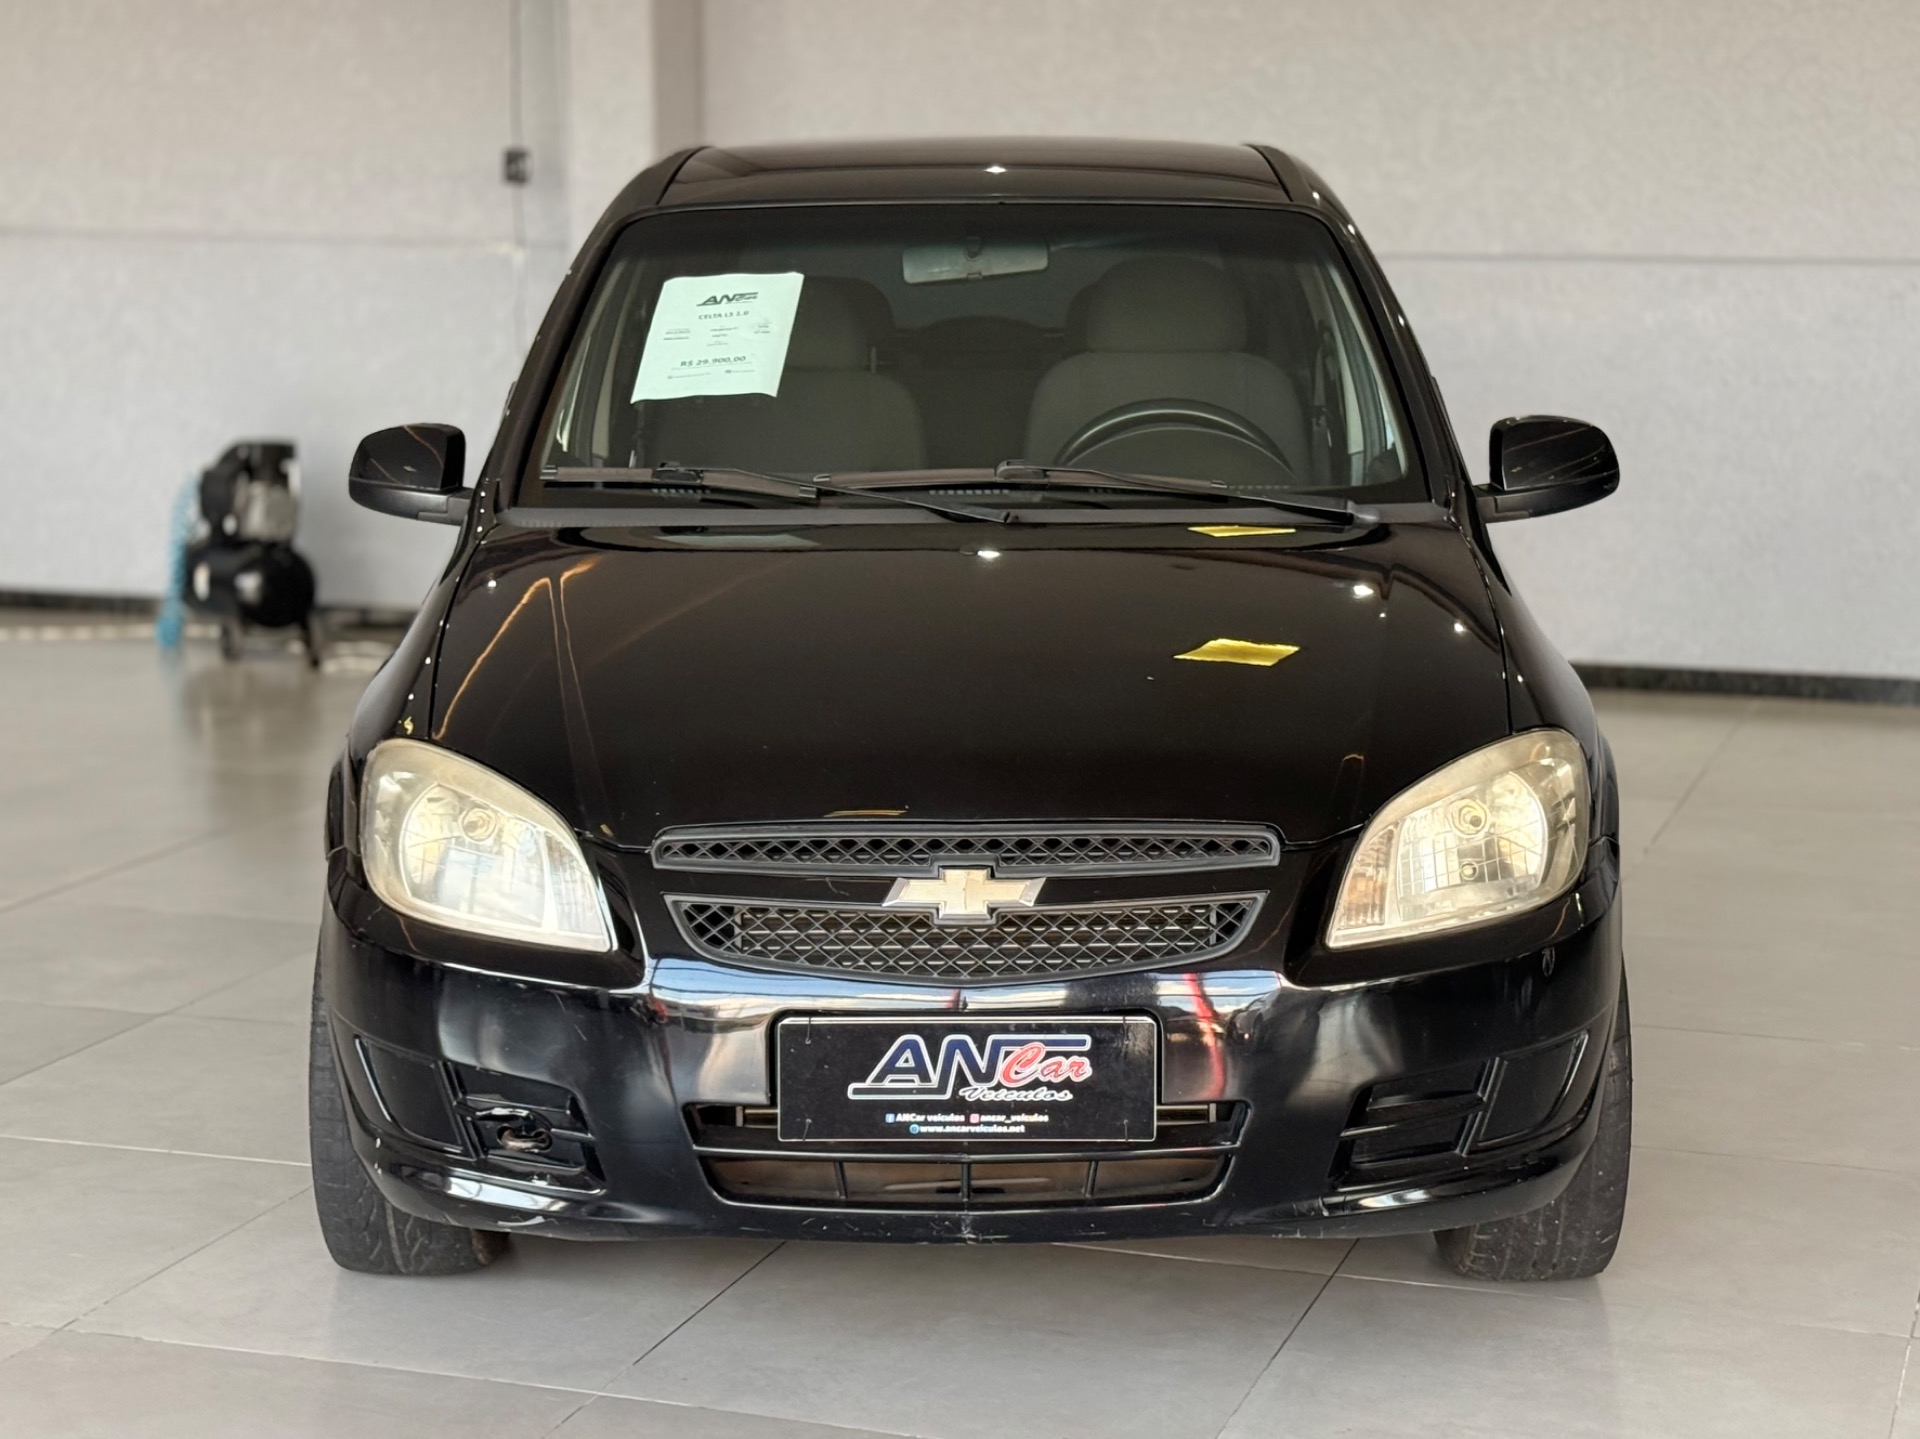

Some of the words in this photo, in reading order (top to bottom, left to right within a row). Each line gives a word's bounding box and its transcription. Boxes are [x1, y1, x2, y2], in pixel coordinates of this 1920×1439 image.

[696, 355, 747, 366] 29.900,00
[896, 1113, 925, 1122] ANCar
[920, 1124, 1025, 1133] www.ancarveiculos.net
